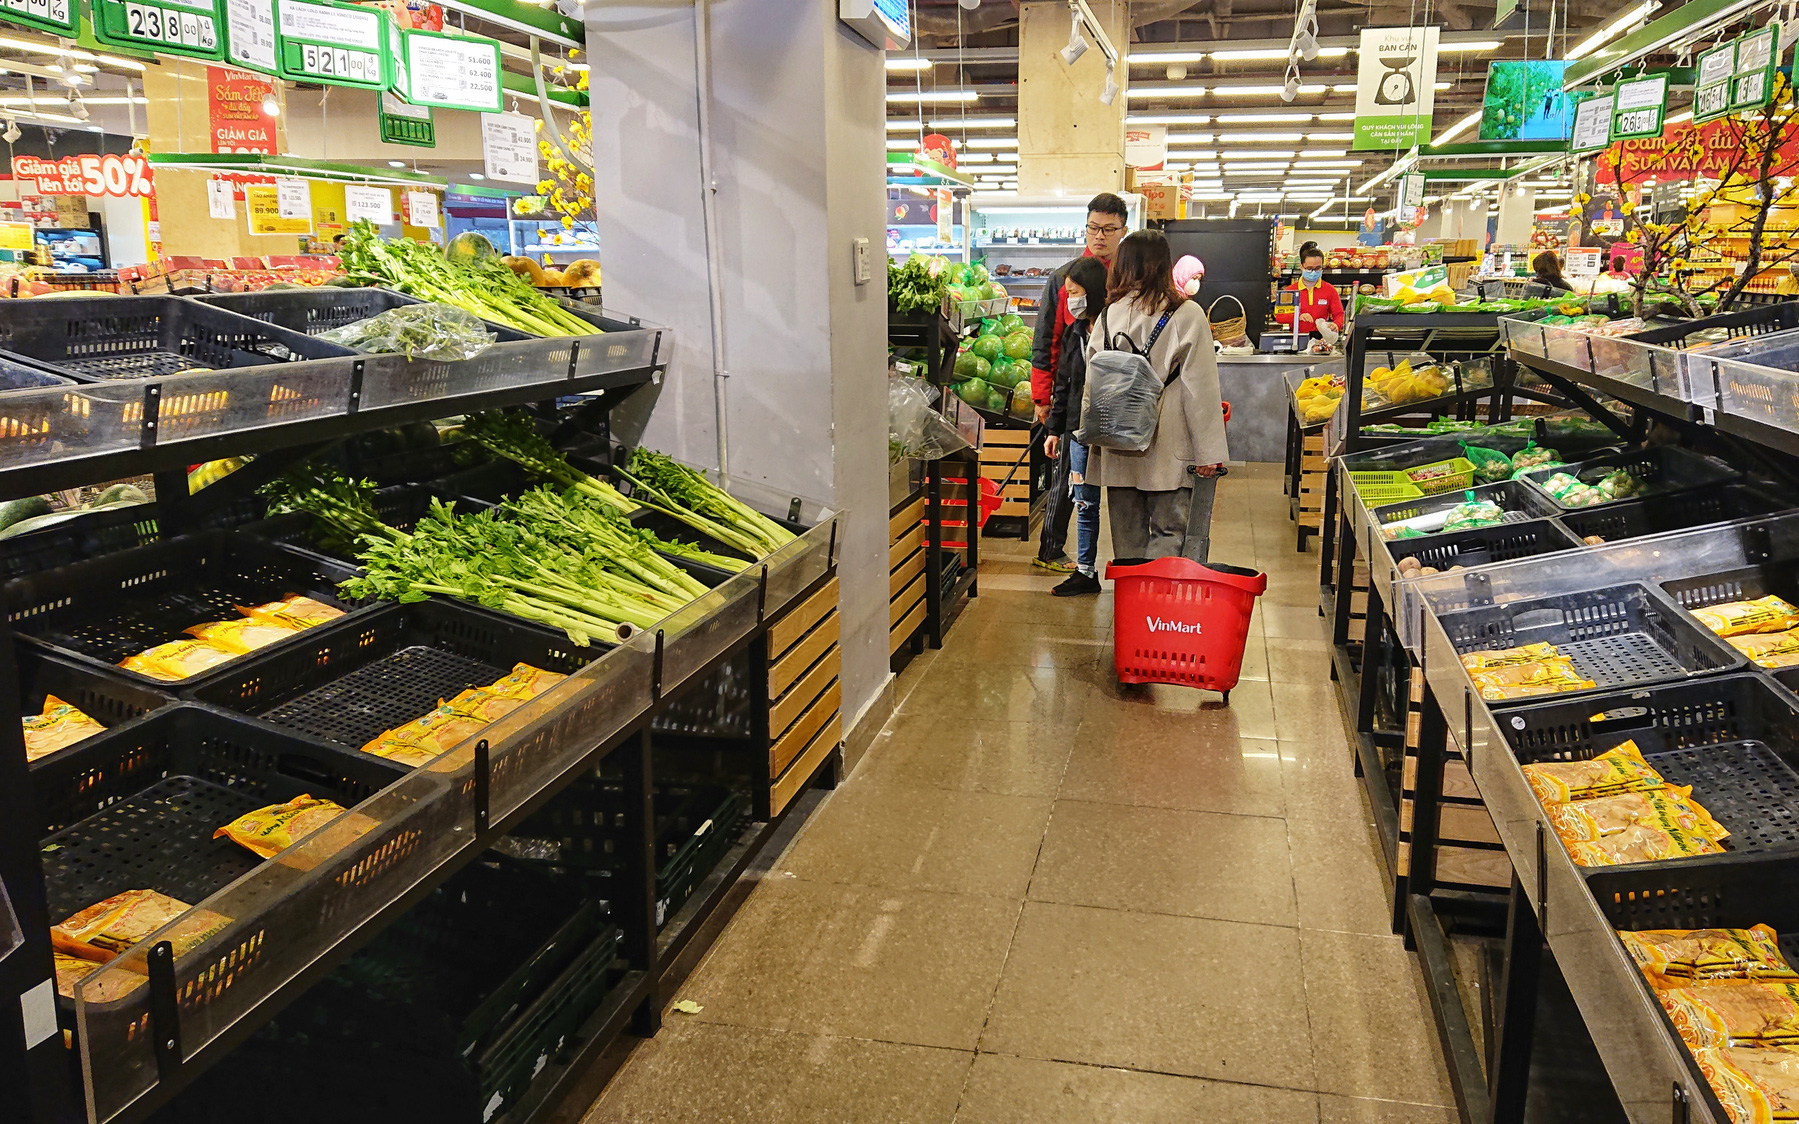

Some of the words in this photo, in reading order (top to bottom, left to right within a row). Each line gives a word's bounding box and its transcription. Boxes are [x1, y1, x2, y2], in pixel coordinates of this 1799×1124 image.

[468, 56, 491, 65] 51.600
[224, 70, 256, 81] VinMar
[469, 69, 492, 79] 62.400
[216, 84, 243, 101] Sắm
[470, 82, 493, 92] 22.500
[217, 126, 246, 140] GIẢM
[248, 127, 268, 141] GIÁ
[1709, 128, 1736, 150] đủ
[16, 158, 57, 175] Giảm
[58, 159, 81, 178] giá
[80, 157, 151, 194] 50%
[38, 176, 62, 192] lên
[1142, 188, 1165, 201] Tipo
[357, 201, 381, 209] 123.500
[1146, 615, 1202, 634] VinMart
